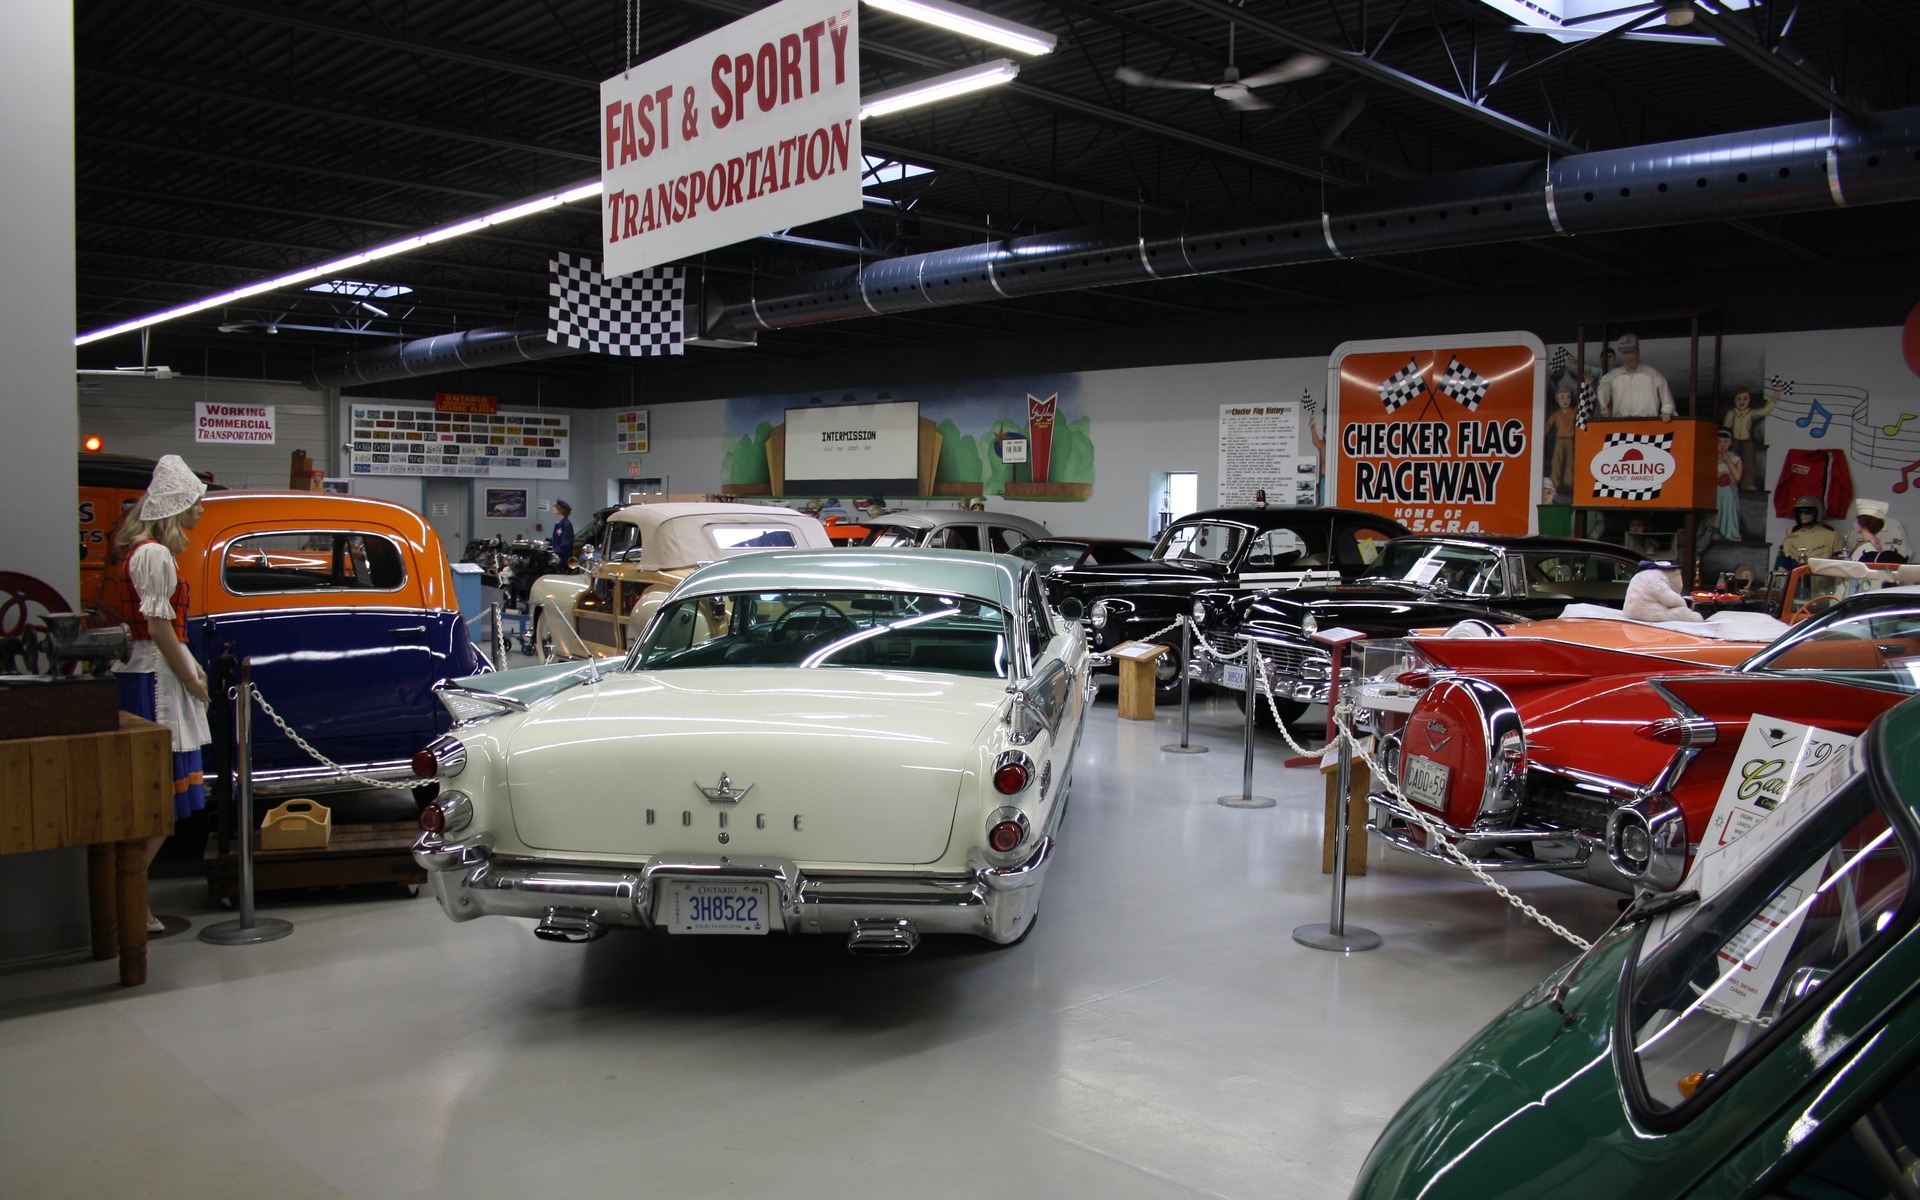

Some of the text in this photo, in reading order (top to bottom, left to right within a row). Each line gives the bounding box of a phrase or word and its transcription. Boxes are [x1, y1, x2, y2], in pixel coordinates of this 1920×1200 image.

[606, 9, 852, 171] FAST & SPORTY
[608, 118, 852, 244] TRANSPORTATION
[206, 405, 266, 417] WORKING
[200, 417, 271, 429] COMMERCIAL
[198, 429, 273, 441] TRANSPORTATION
[822, 431, 876, 441] INTERMISSION
[1342, 419, 1526, 458] CHECKER FLAG
[1601, 463, 1665, 475] CARLING
[1355, 460, 1504, 504] RACEWAY
[1394, 508, 1462, 520] HOME OF
[698, 886, 737, 895] ONTARIO
[689, 896, 758, 921] 3H8522
[1730, 986, 1746, 997] CANADA
